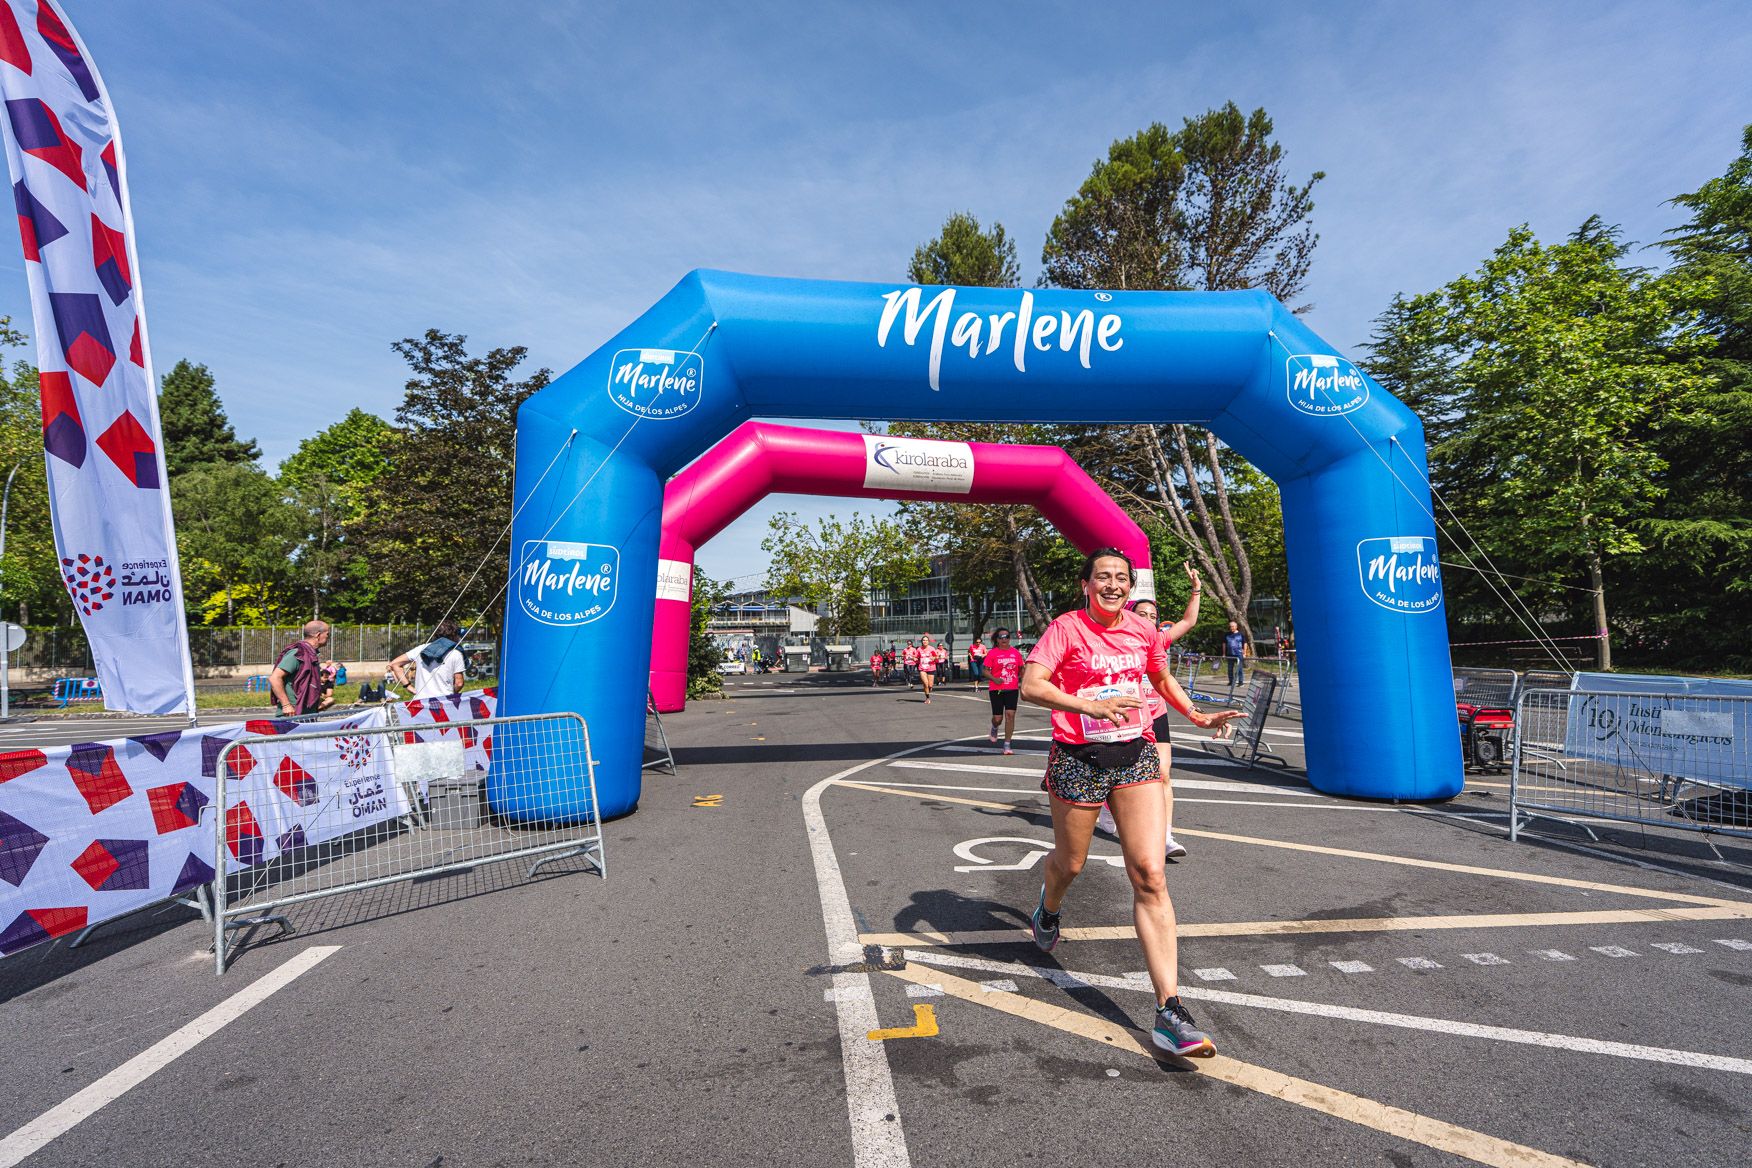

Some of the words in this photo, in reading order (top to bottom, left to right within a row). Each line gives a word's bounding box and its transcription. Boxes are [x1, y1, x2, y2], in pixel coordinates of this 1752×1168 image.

[877, 287, 1123, 391] Marlene
[615, 362, 695, 397] Marlene
[618, 394, 633, 407] HIJA
[635, 405, 645, 413] DE
[648, 407, 663, 415] LOS
[665, 403, 688, 415] ALPES
[1298, 399, 1313, 411] HIJA
[895, 450, 967, 469] kirolaraba
[524, 559, 611, 601] Marlene
[657, 573, 688, 586] olaraba
[526, 599, 539, 615] HIJA
[541, 610, 553, 619] DE
[555, 613, 571, 621] LOS
[574, 604, 601, 620] ALPES
[1376, 592, 1395, 605] HIJA
[1398, 600, 1409, 608] DE
[1411, 600, 1425, 608] LOS
[353, 797, 387, 818] OMAN
